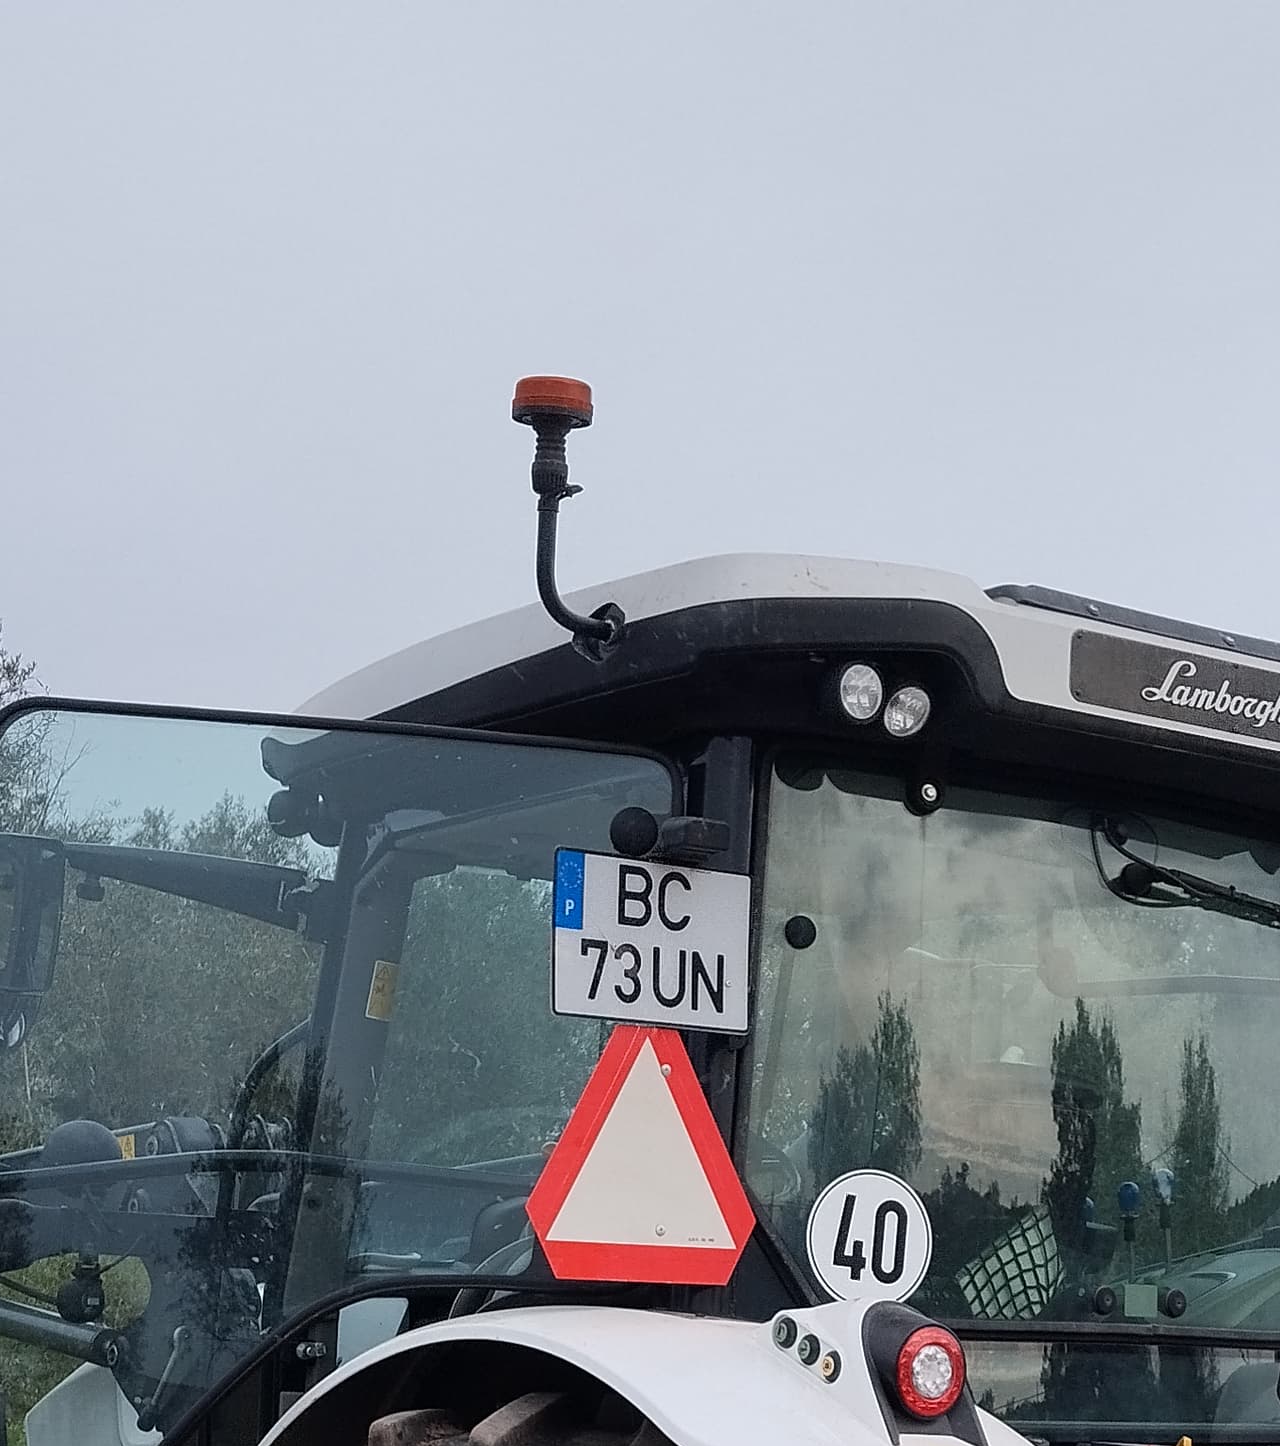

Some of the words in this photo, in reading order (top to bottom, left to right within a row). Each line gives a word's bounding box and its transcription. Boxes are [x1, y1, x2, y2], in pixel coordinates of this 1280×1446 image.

[564, 898, 576, 916] P
[618, 863, 692, 932] BC
[832, 1193, 908, 1285] 40
